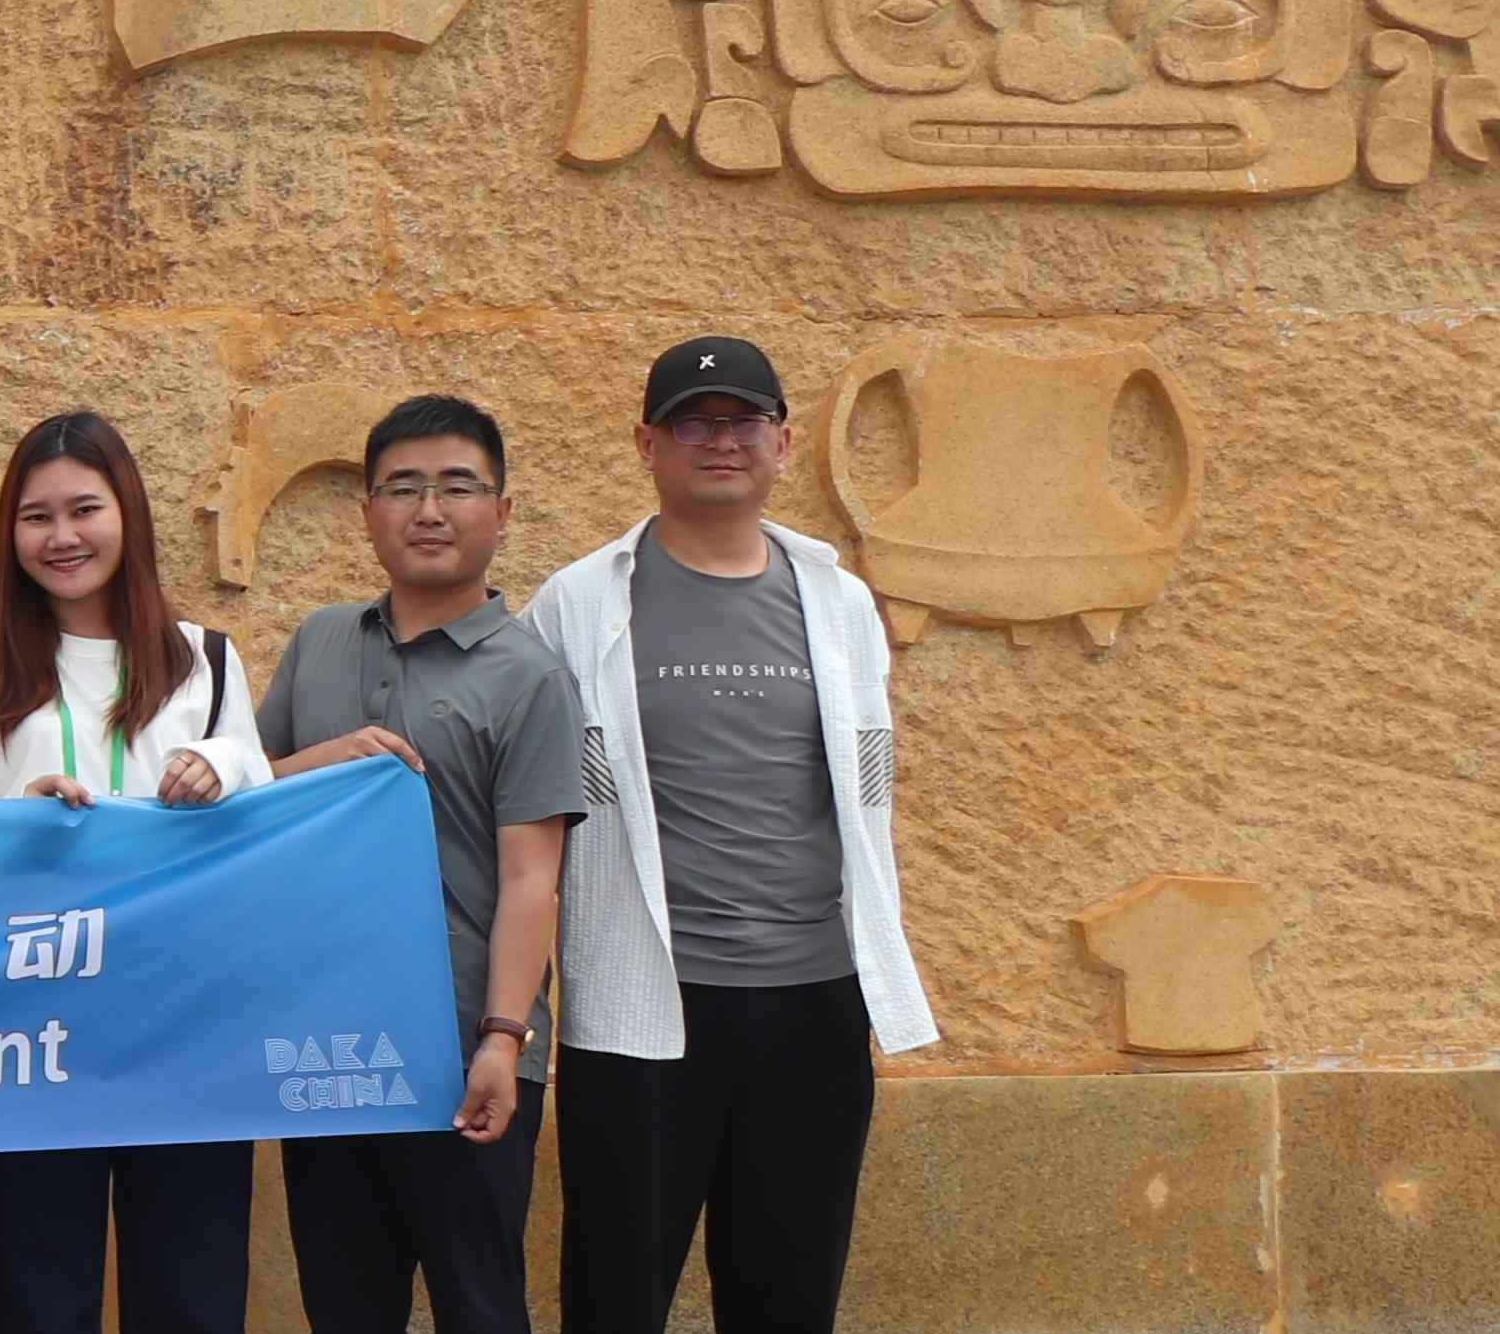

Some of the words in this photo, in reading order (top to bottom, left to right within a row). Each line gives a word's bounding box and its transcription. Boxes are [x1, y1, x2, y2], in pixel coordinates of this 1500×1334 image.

[658, 663, 813, 680] FRIENDSHIPS
[263, 1031, 405, 1074] DAKA
[278, 1072, 419, 1112] CHINA
